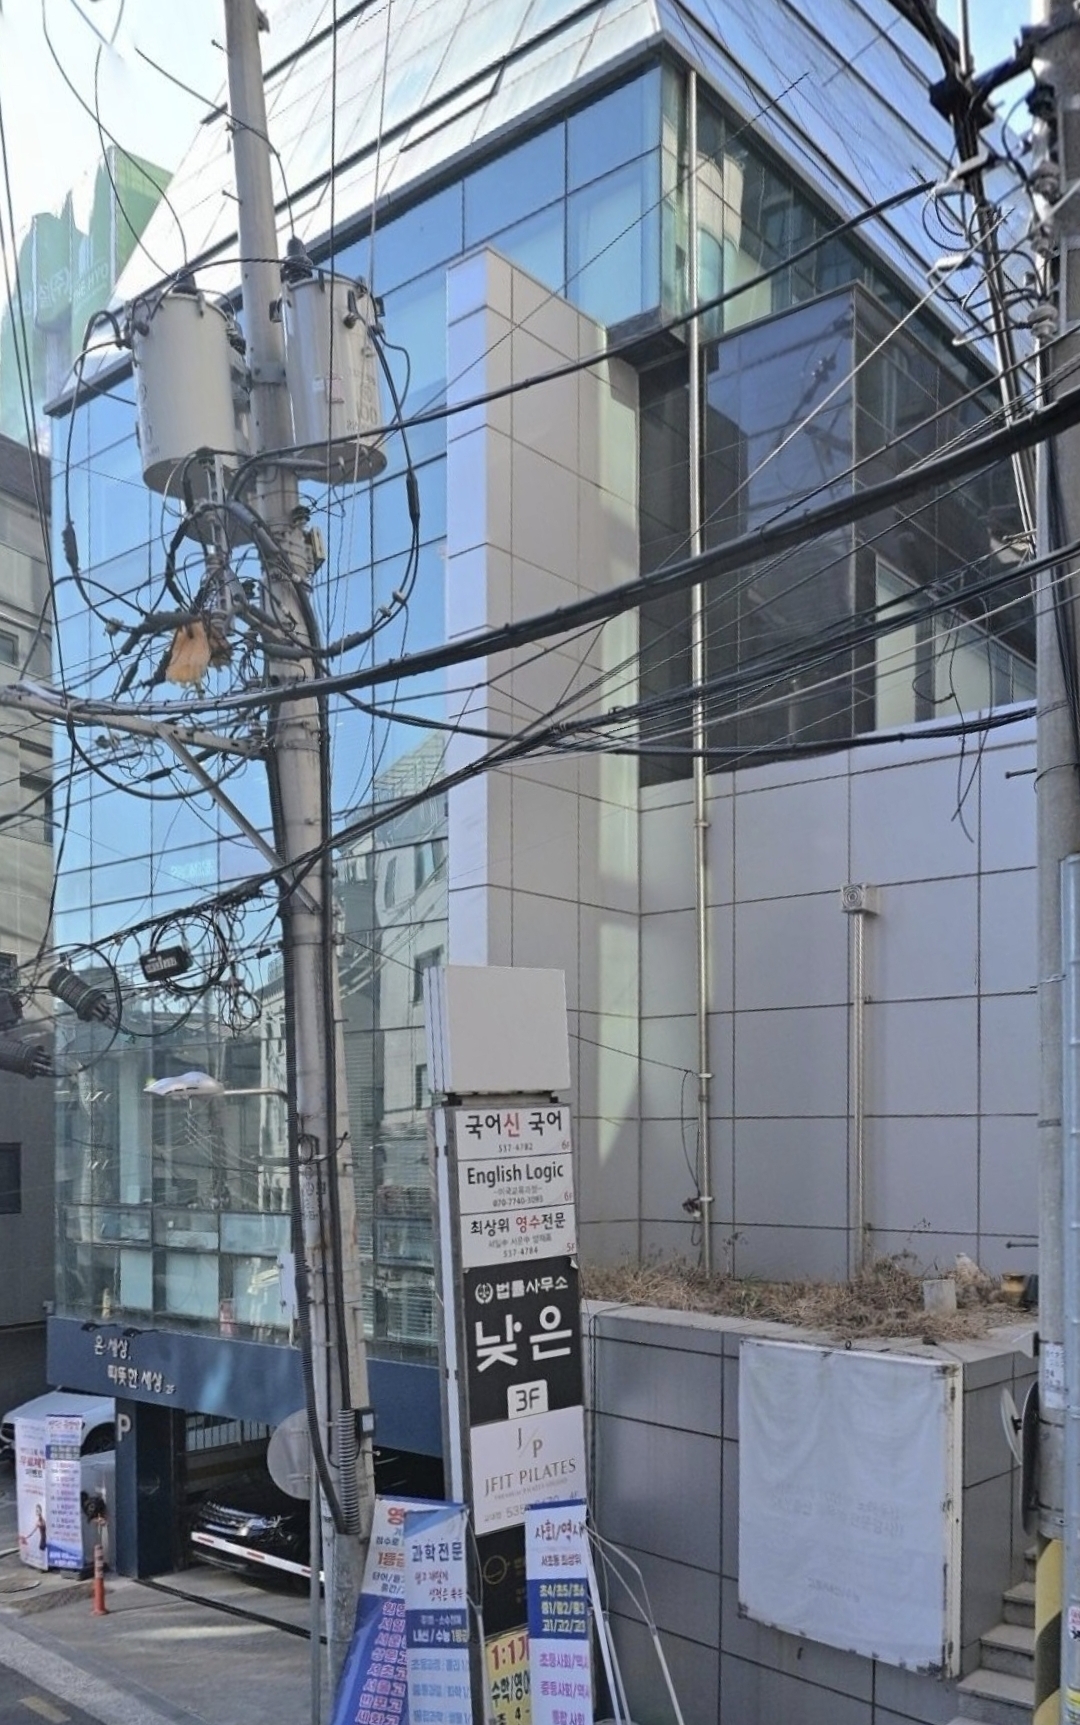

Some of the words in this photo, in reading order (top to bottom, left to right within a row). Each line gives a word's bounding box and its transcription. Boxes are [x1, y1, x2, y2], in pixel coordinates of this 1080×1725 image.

[465, 1112, 520, 1140] 국어신
[529, 1110, 562, 1136] 국어
[468, 1164, 522, 1188] English
[526, 1162, 564, 1182] Logic
[470, 1218, 510, 1237] 최상위
[516, 1212, 566, 1234] 영수전문
[566, 1242, 575, 1252] 5F
[496, 1276, 568, 1300] 법률사무소
[475, 1305, 572, 1372] 낮은
[108, 1364, 138, 1389] 따뜻한
[141, 1370, 162, 1393] 세상
[515, 1387, 540, 1412] 3F
[117, 1414, 132, 1442] P
[484, 1472, 513, 1497] JFIT
[520, 1458, 576, 1485] PILATES
[412, 1542, 462, 1562] 과학전문
